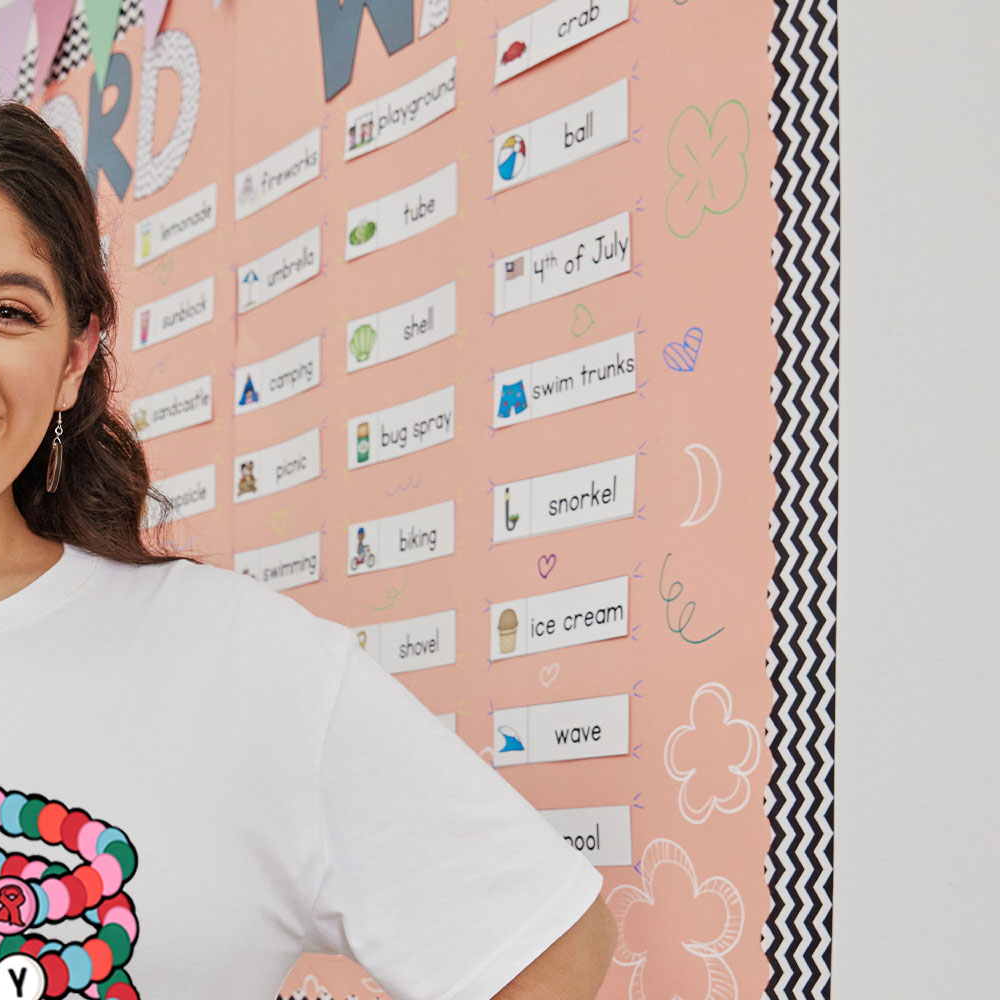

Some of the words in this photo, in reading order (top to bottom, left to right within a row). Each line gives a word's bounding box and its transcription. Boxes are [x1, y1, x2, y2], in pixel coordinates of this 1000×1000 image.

[557, 0, 600, 37] crab
[377, 66, 456, 136] playground
[564, 110, 594, 148] ball
[260, 147, 319, 194] fireworks
[160, 199, 212, 241] lemonade
[403, 194, 435, 225] tube
[266, 245, 314, 287] umbrella
[564, 243, 585, 274] of
[592, 230, 629, 264] July
[162, 292, 207, 330] sunblock
[403, 305, 434, 341] shell
[269, 361, 313, 391] camping
[531, 375, 574, 400] swim
[580, 352, 635, 386] trunks
[152, 387, 210, 423] sandcastle
[381, 424, 407, 448] bug
[412, 411, 452, 442] spray
[275, 454, 307, 485] picnic
[170, 481, 207, 514] psicle
[548, 475, 617, 516] snorkel
[399, 526, 437, 552] biking
[262, 554, 317, 582] swimming
[531, 617, 556, 638] ice
[563, 603, 624, 632] cream
[399, 626, 440, 659] shovel
[554, 725, 602, 745] wave
